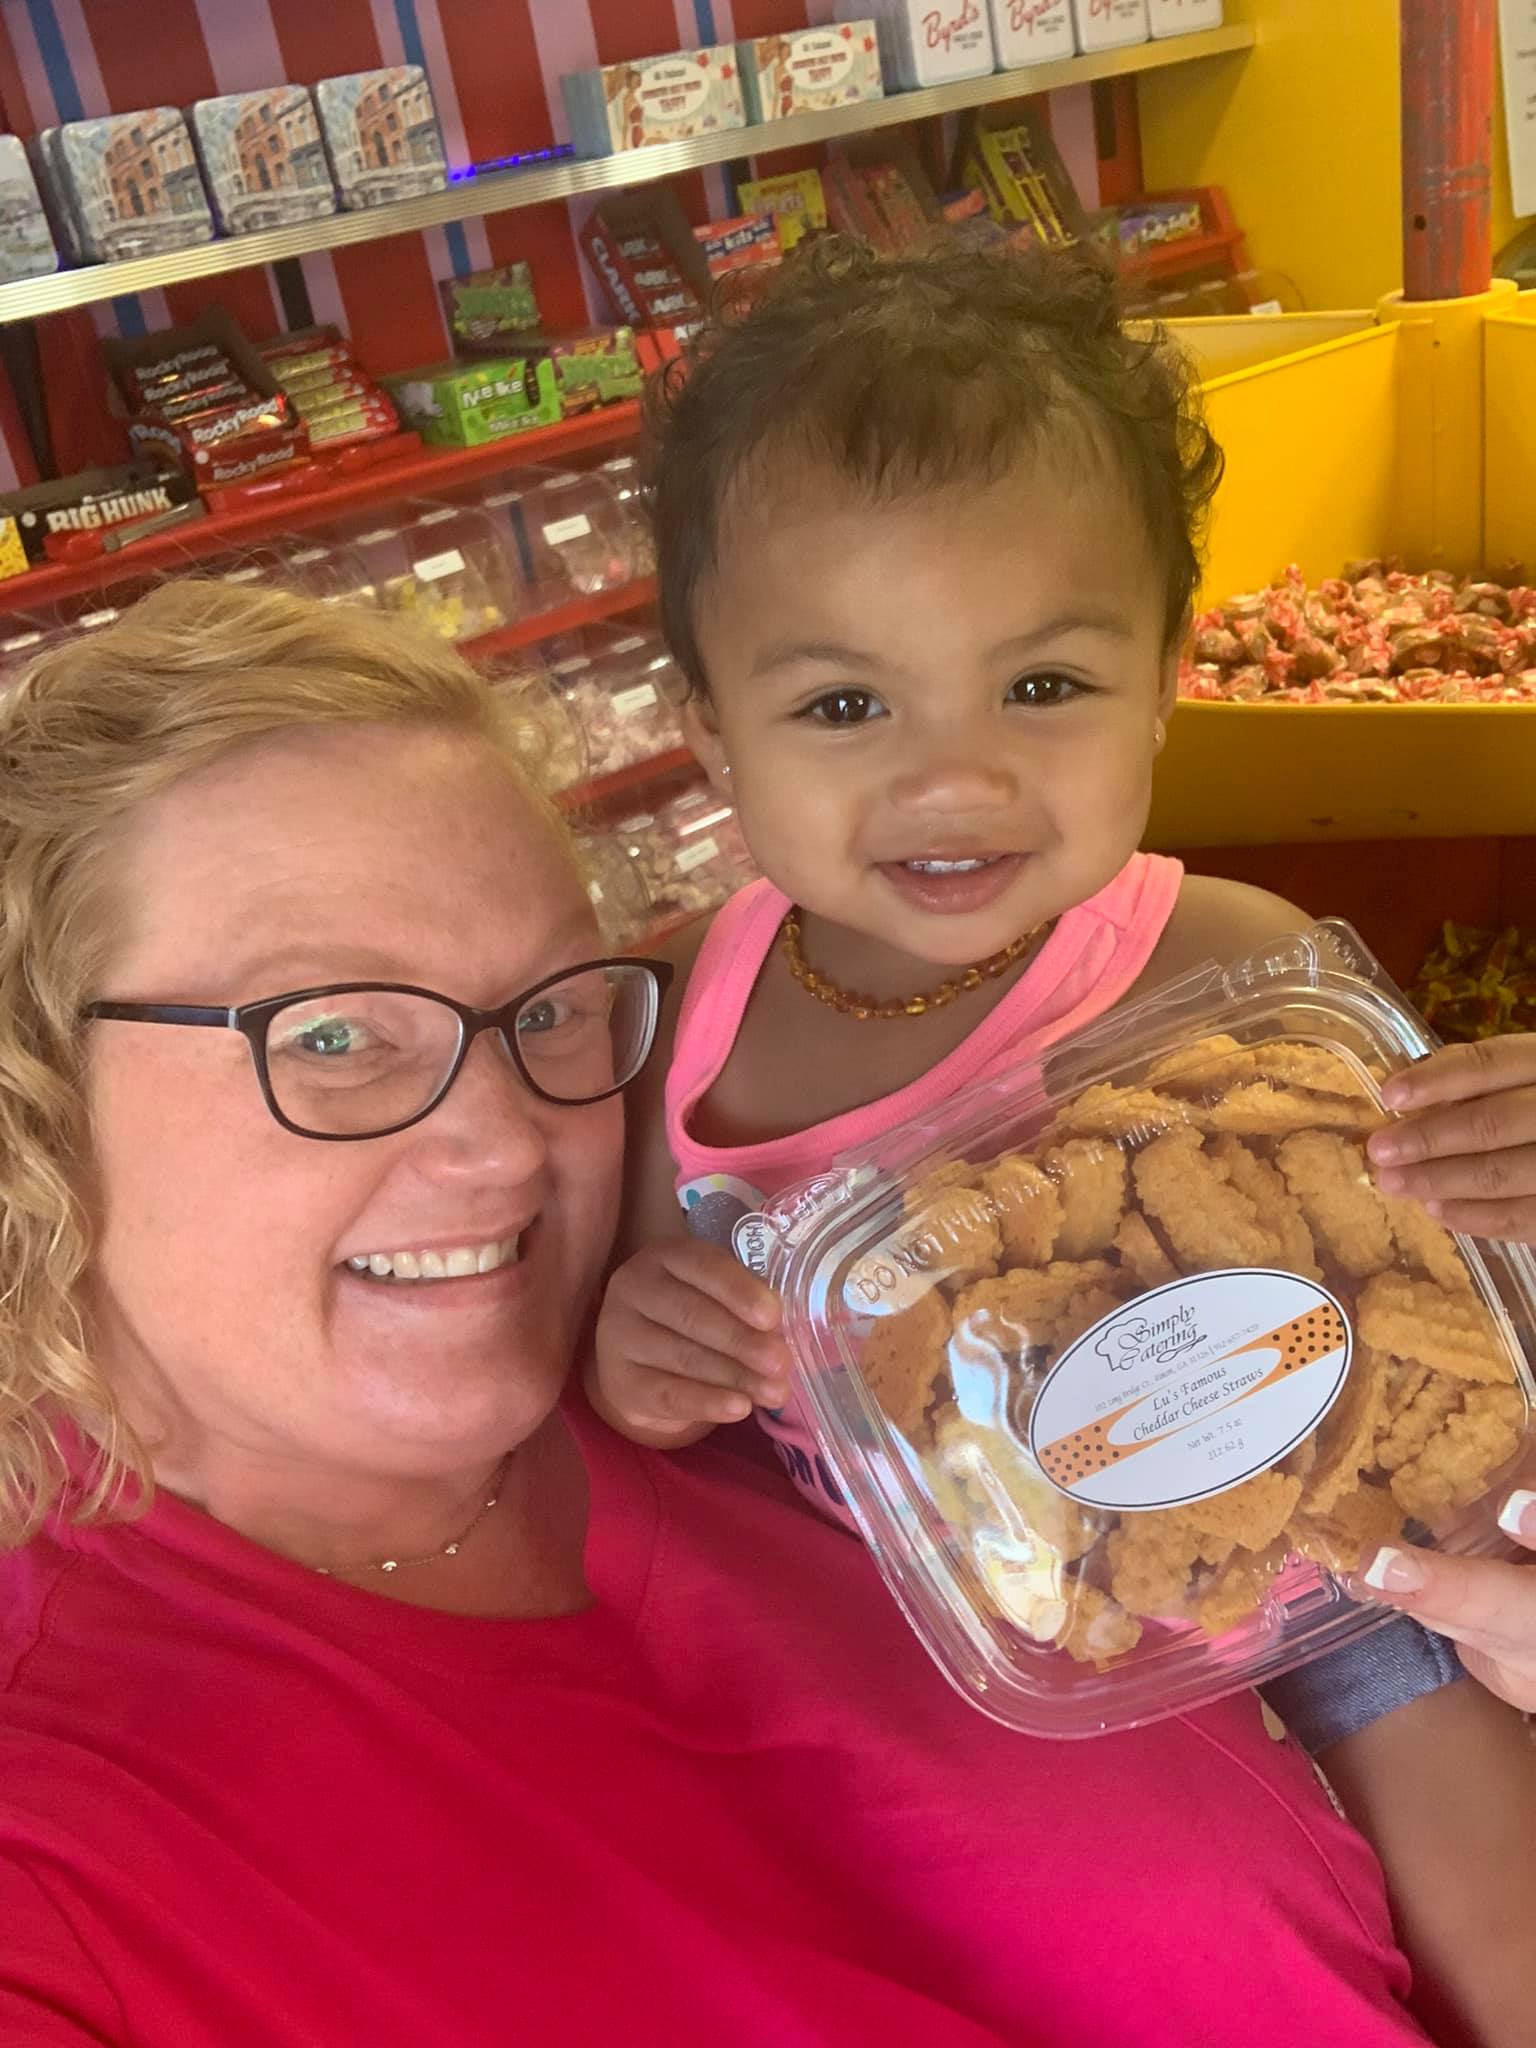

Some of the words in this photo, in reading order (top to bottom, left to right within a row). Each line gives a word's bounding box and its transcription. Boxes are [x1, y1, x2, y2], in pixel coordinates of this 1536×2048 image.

[592, 236, 641, 322] CLARK
[100, 486, 173, 524] HUNK
[857, 1265, 897, 1305] DO
[1119, 1305, 1196, 1348] Simply
[1119, 1323, 1199, 1371] Catering
[1132, 1409, 1180, 1441] Cheddar
[1182, 1389, 1220, 1417] Cheese
[1222, 1368, 1264, 1397] Straws
[1152, 1389, 1180, 1411] Lu's
[1181, 1367, 1227, 1396] Famous
